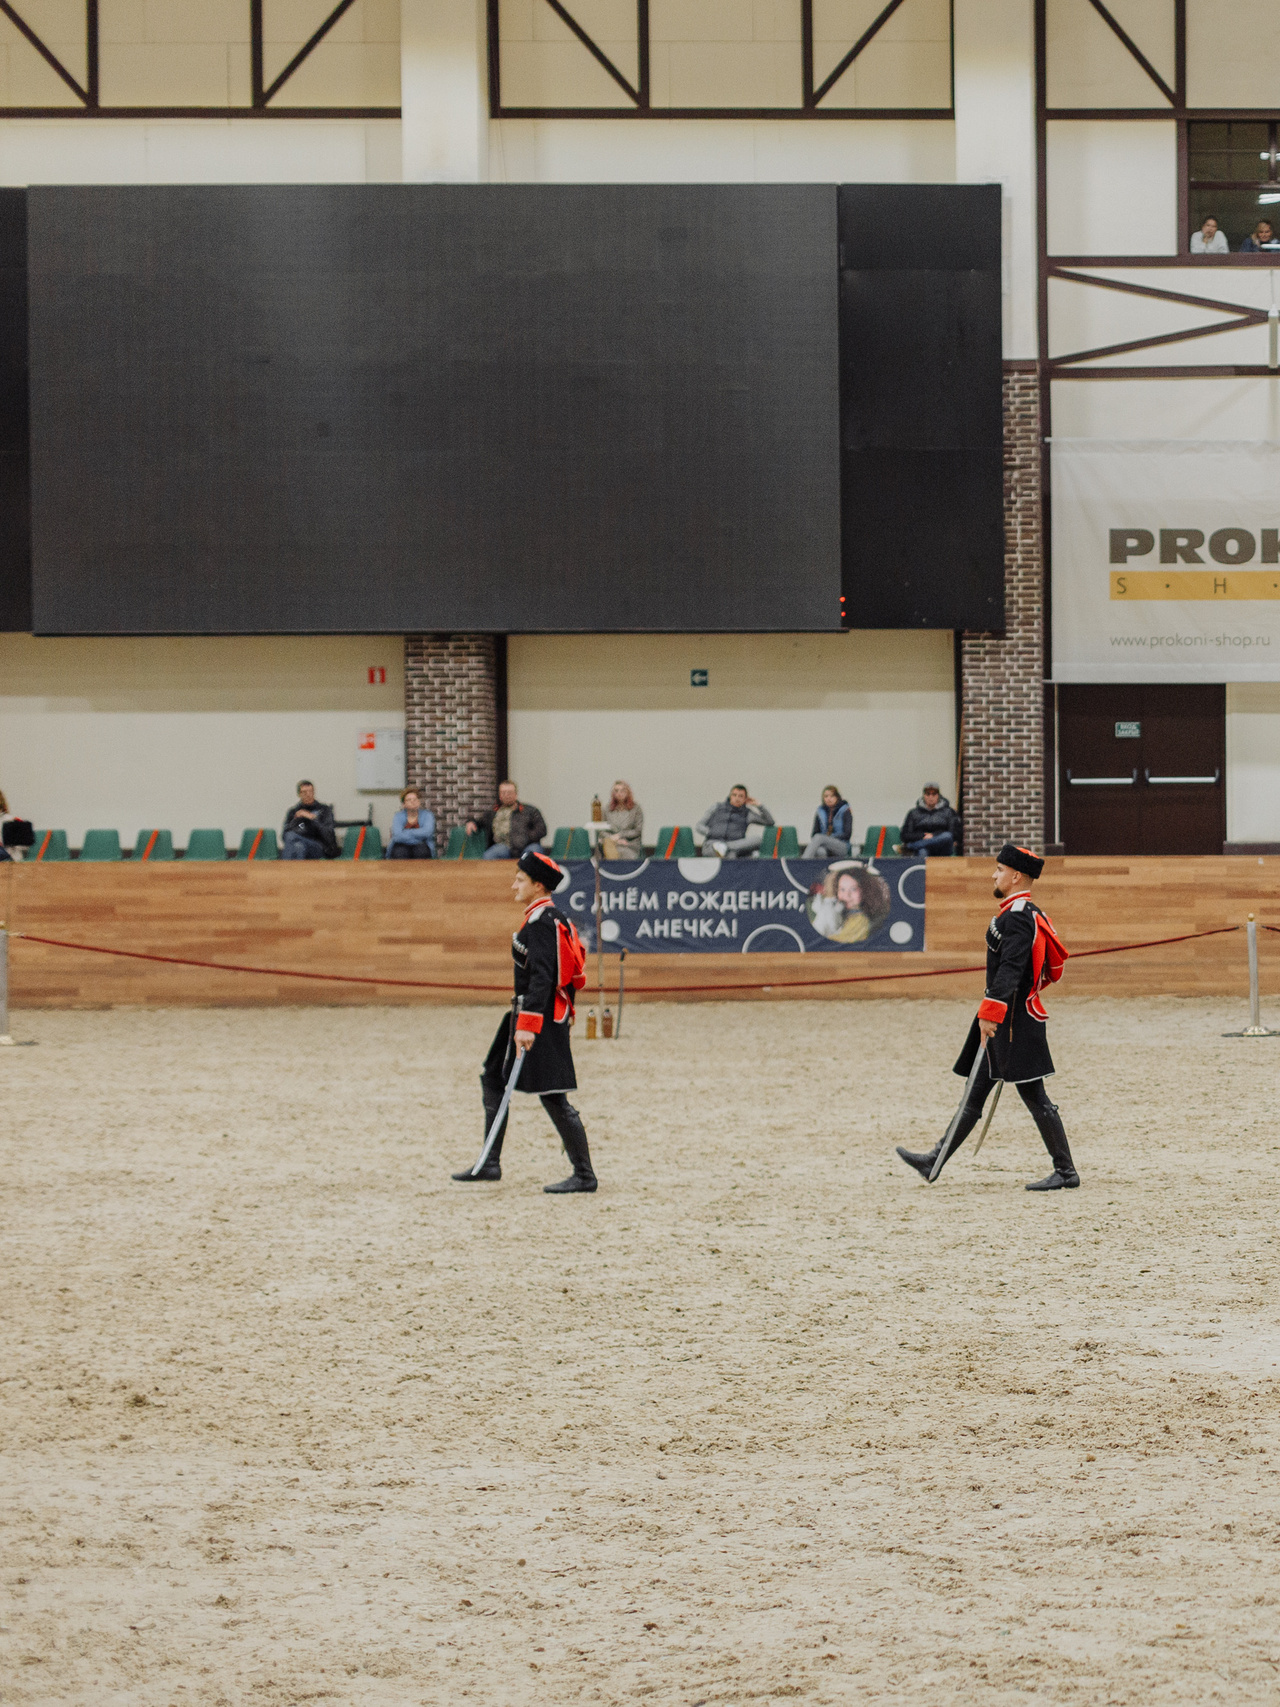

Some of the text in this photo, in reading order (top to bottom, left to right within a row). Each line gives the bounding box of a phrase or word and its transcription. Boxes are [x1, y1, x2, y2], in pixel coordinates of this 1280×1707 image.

[1109, 632, 1271, 649] www.prokoni-shop.ru
[569, 887, 807, 915] С ДНЁМ РОЖДЕНИЯ,
[635, 918, 738, 938] АНЕЧКА!
